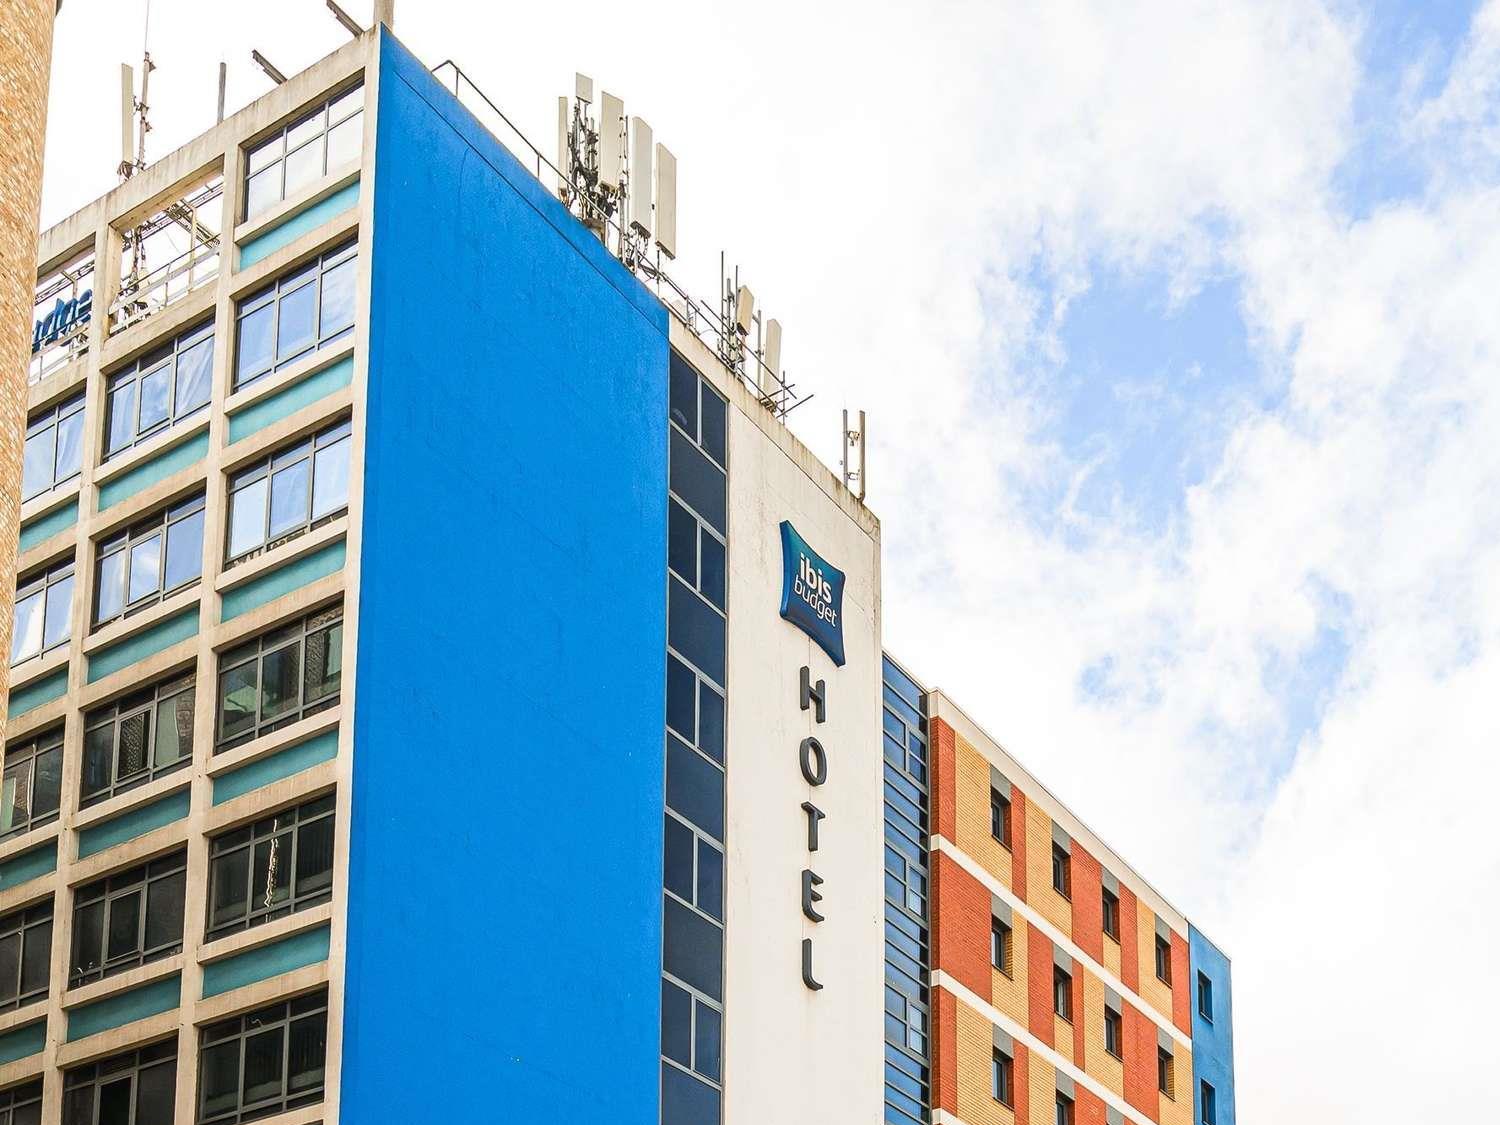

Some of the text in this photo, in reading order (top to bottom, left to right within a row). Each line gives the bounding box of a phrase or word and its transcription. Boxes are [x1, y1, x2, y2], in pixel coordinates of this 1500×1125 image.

[794, 574, 837, 627] budget
[800, 552, 832, 604] ibis
[799, 664, 827, 993] HOTEL
